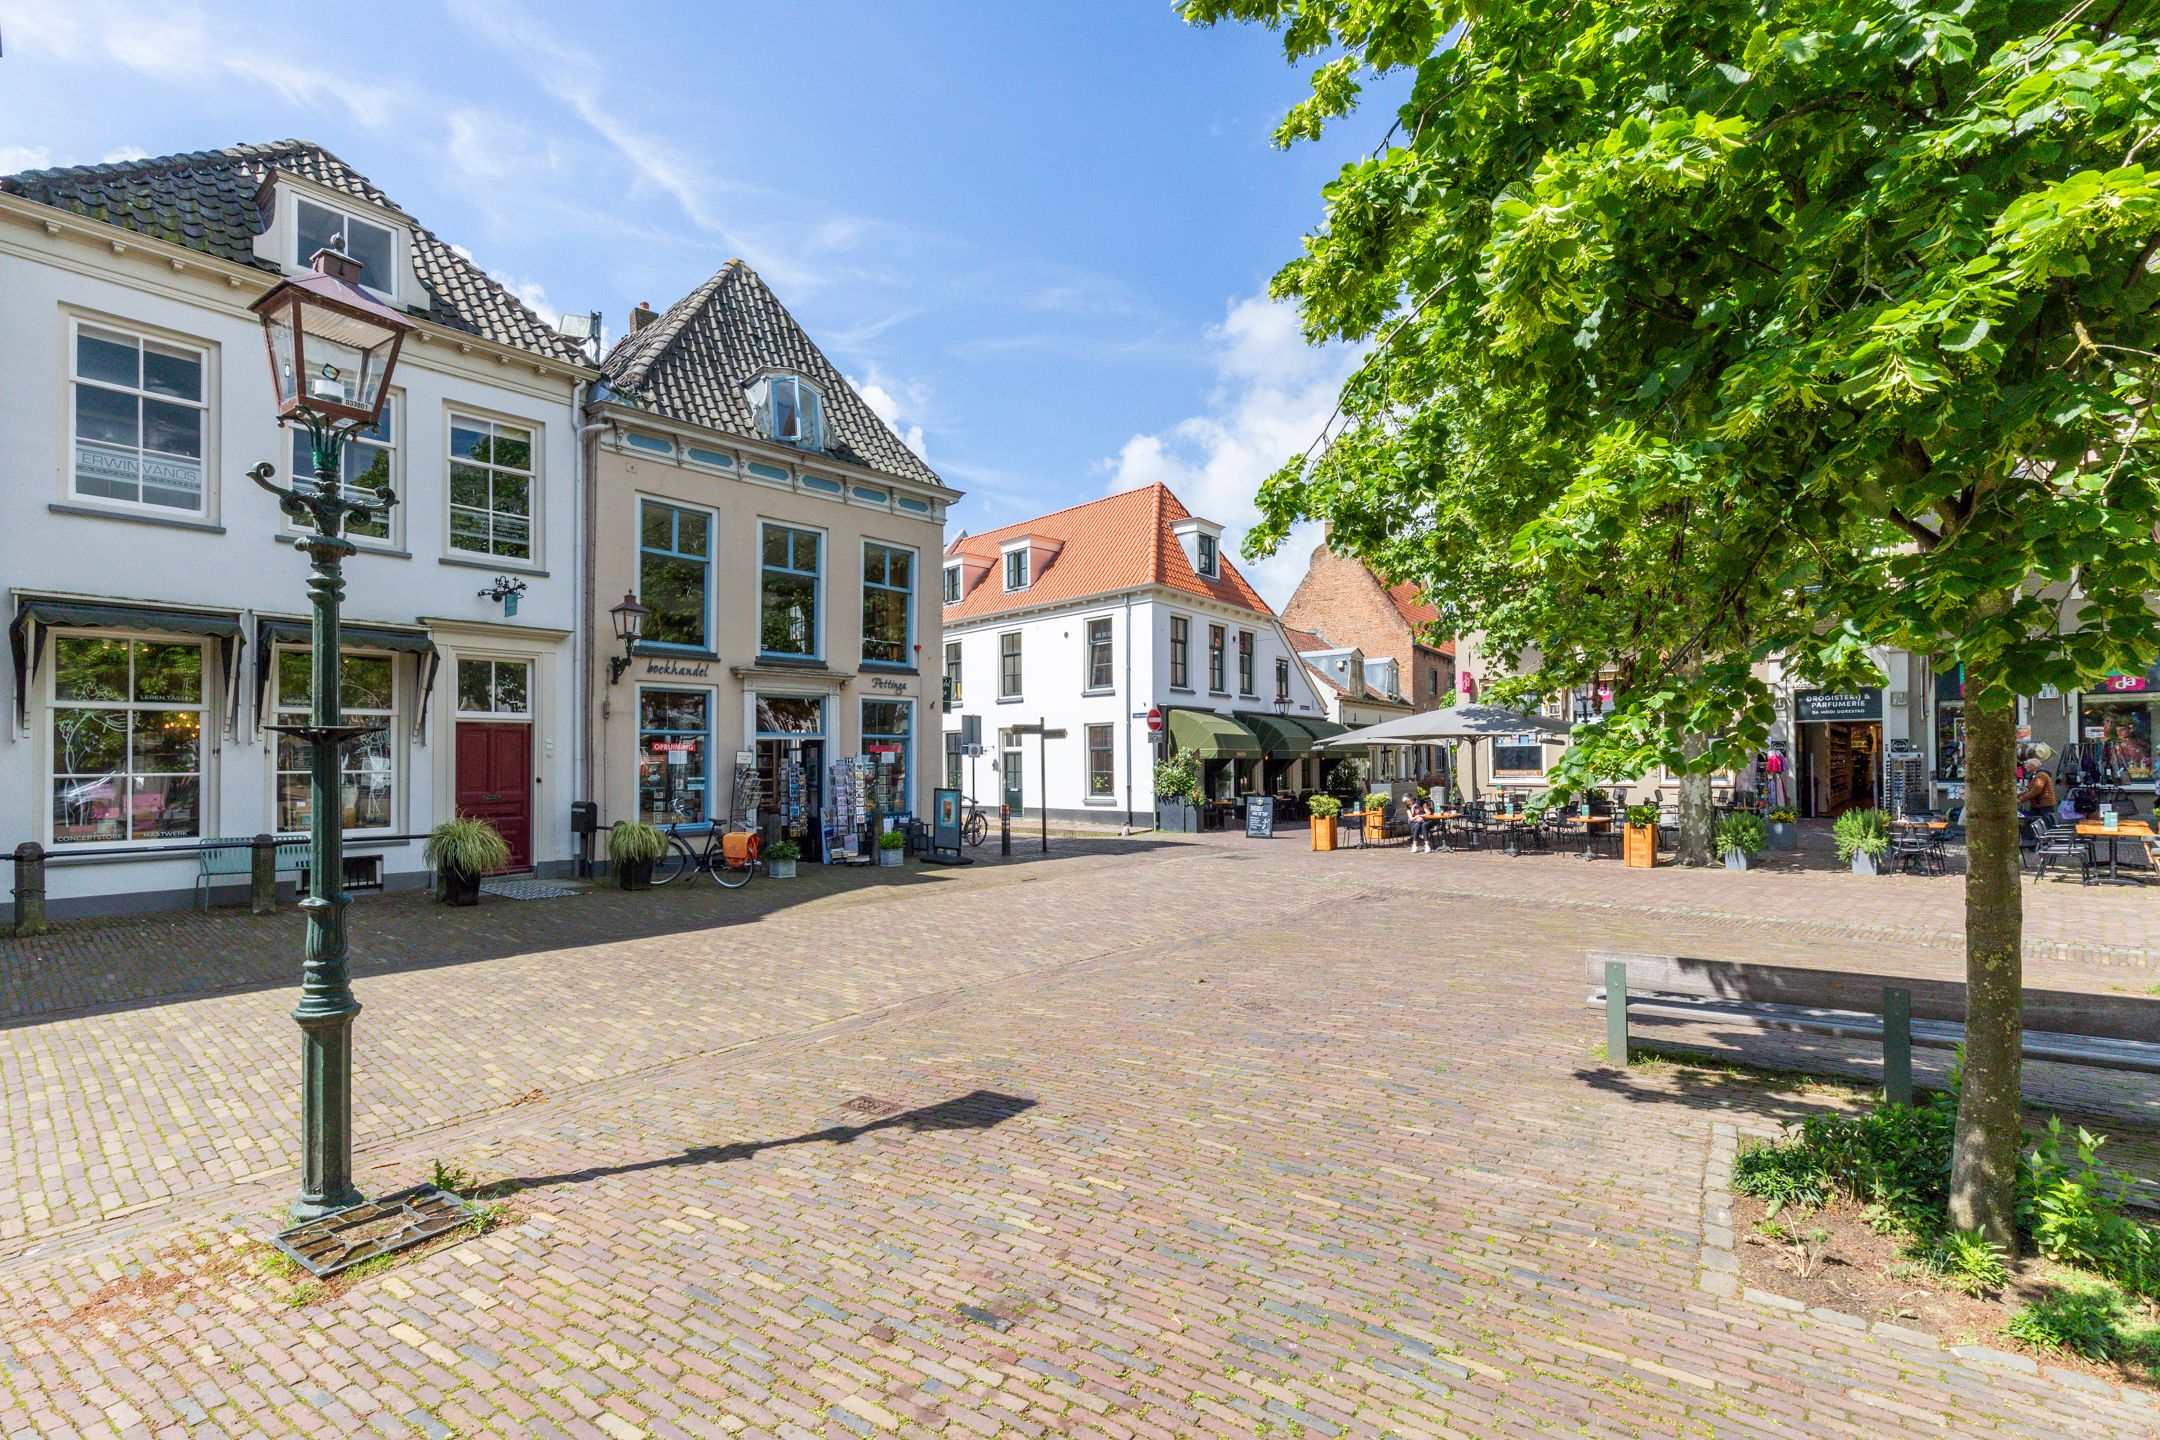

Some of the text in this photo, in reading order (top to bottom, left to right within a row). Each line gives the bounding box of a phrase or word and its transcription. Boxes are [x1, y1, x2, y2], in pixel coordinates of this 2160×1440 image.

[647, 658, 709, 677] boekhandel
[871, 677, 908, 696] Pettinga
[2115, 676, 2136, 689] da
[1811, 700, 1866, 708] PARFUMERIE
[654, 742, 695, 752] OPRUIMING
[57, 833, 123, 842] CONCEPTSTORE
